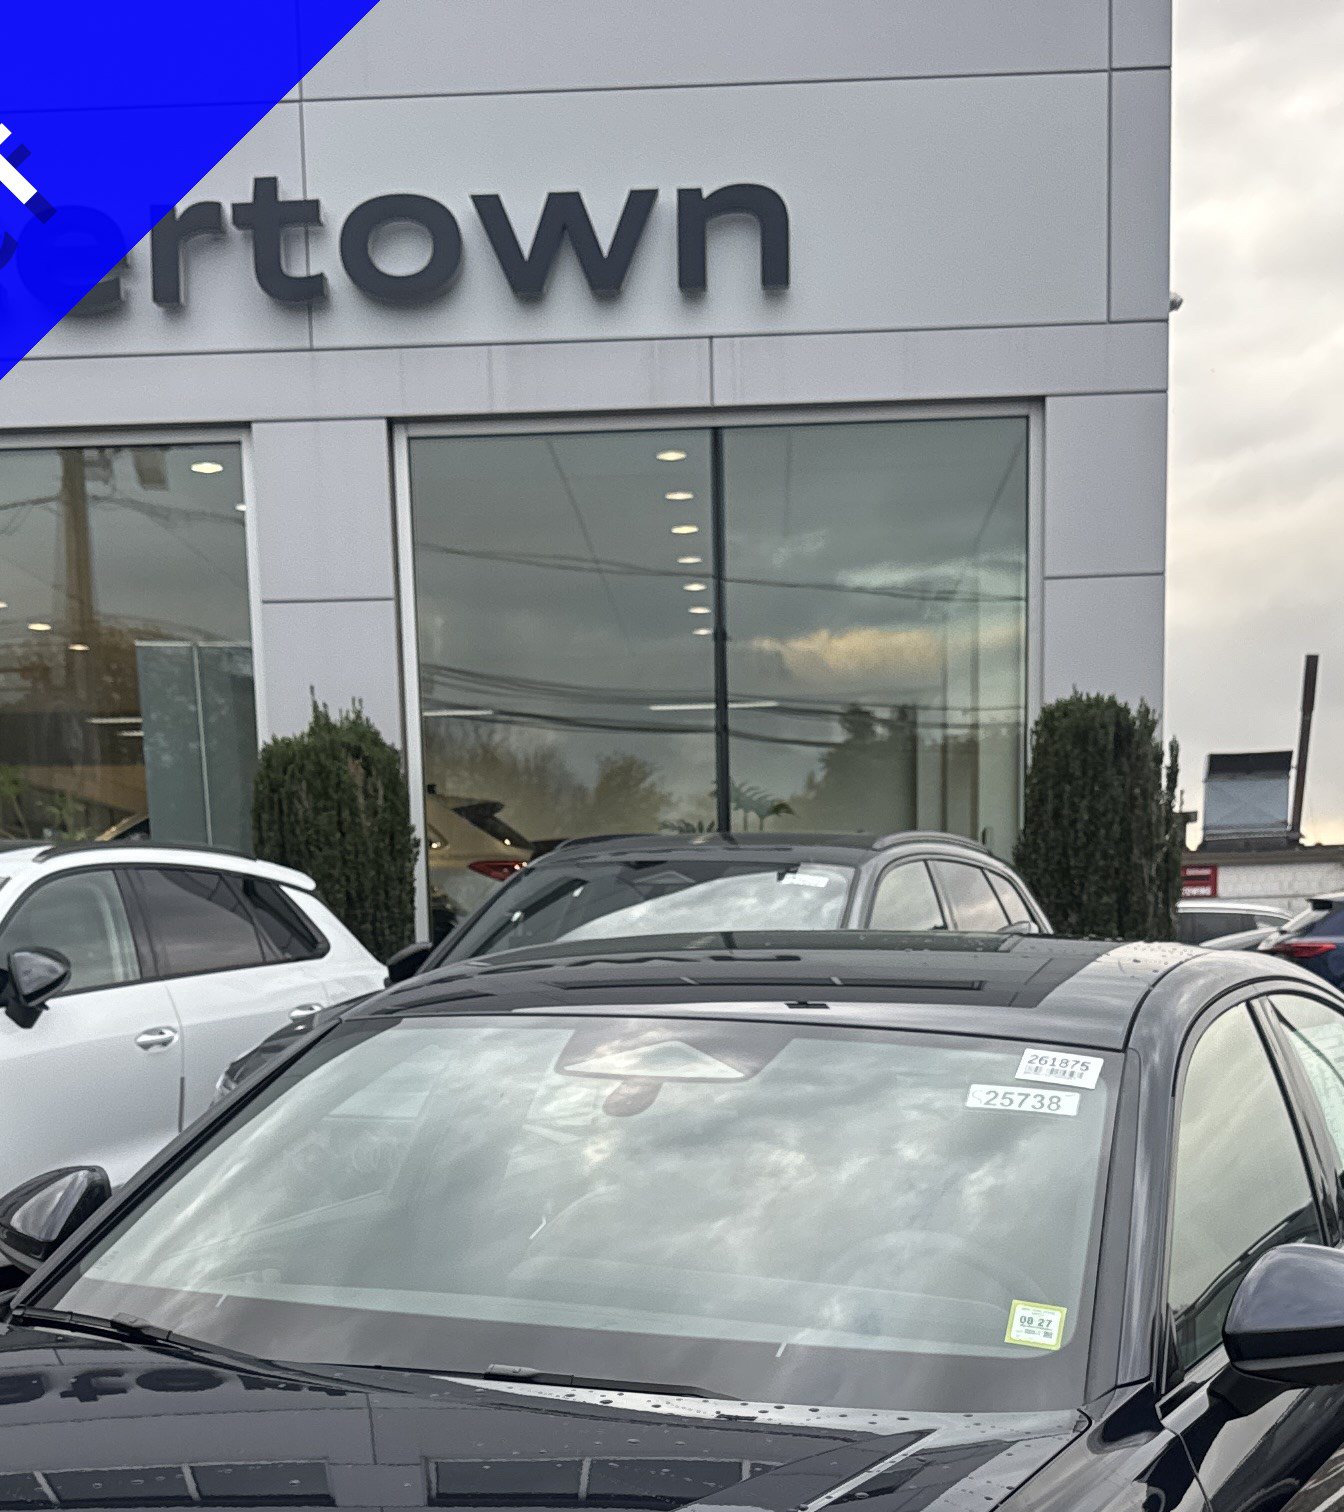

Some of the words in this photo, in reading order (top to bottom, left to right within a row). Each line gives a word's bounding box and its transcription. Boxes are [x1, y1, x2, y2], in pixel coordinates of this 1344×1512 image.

[1027, 1054, 1091, 1071] 261875
[983, 1090, 1062, 1112] 25738
[1037, 1318, 1053, 1328] 27
